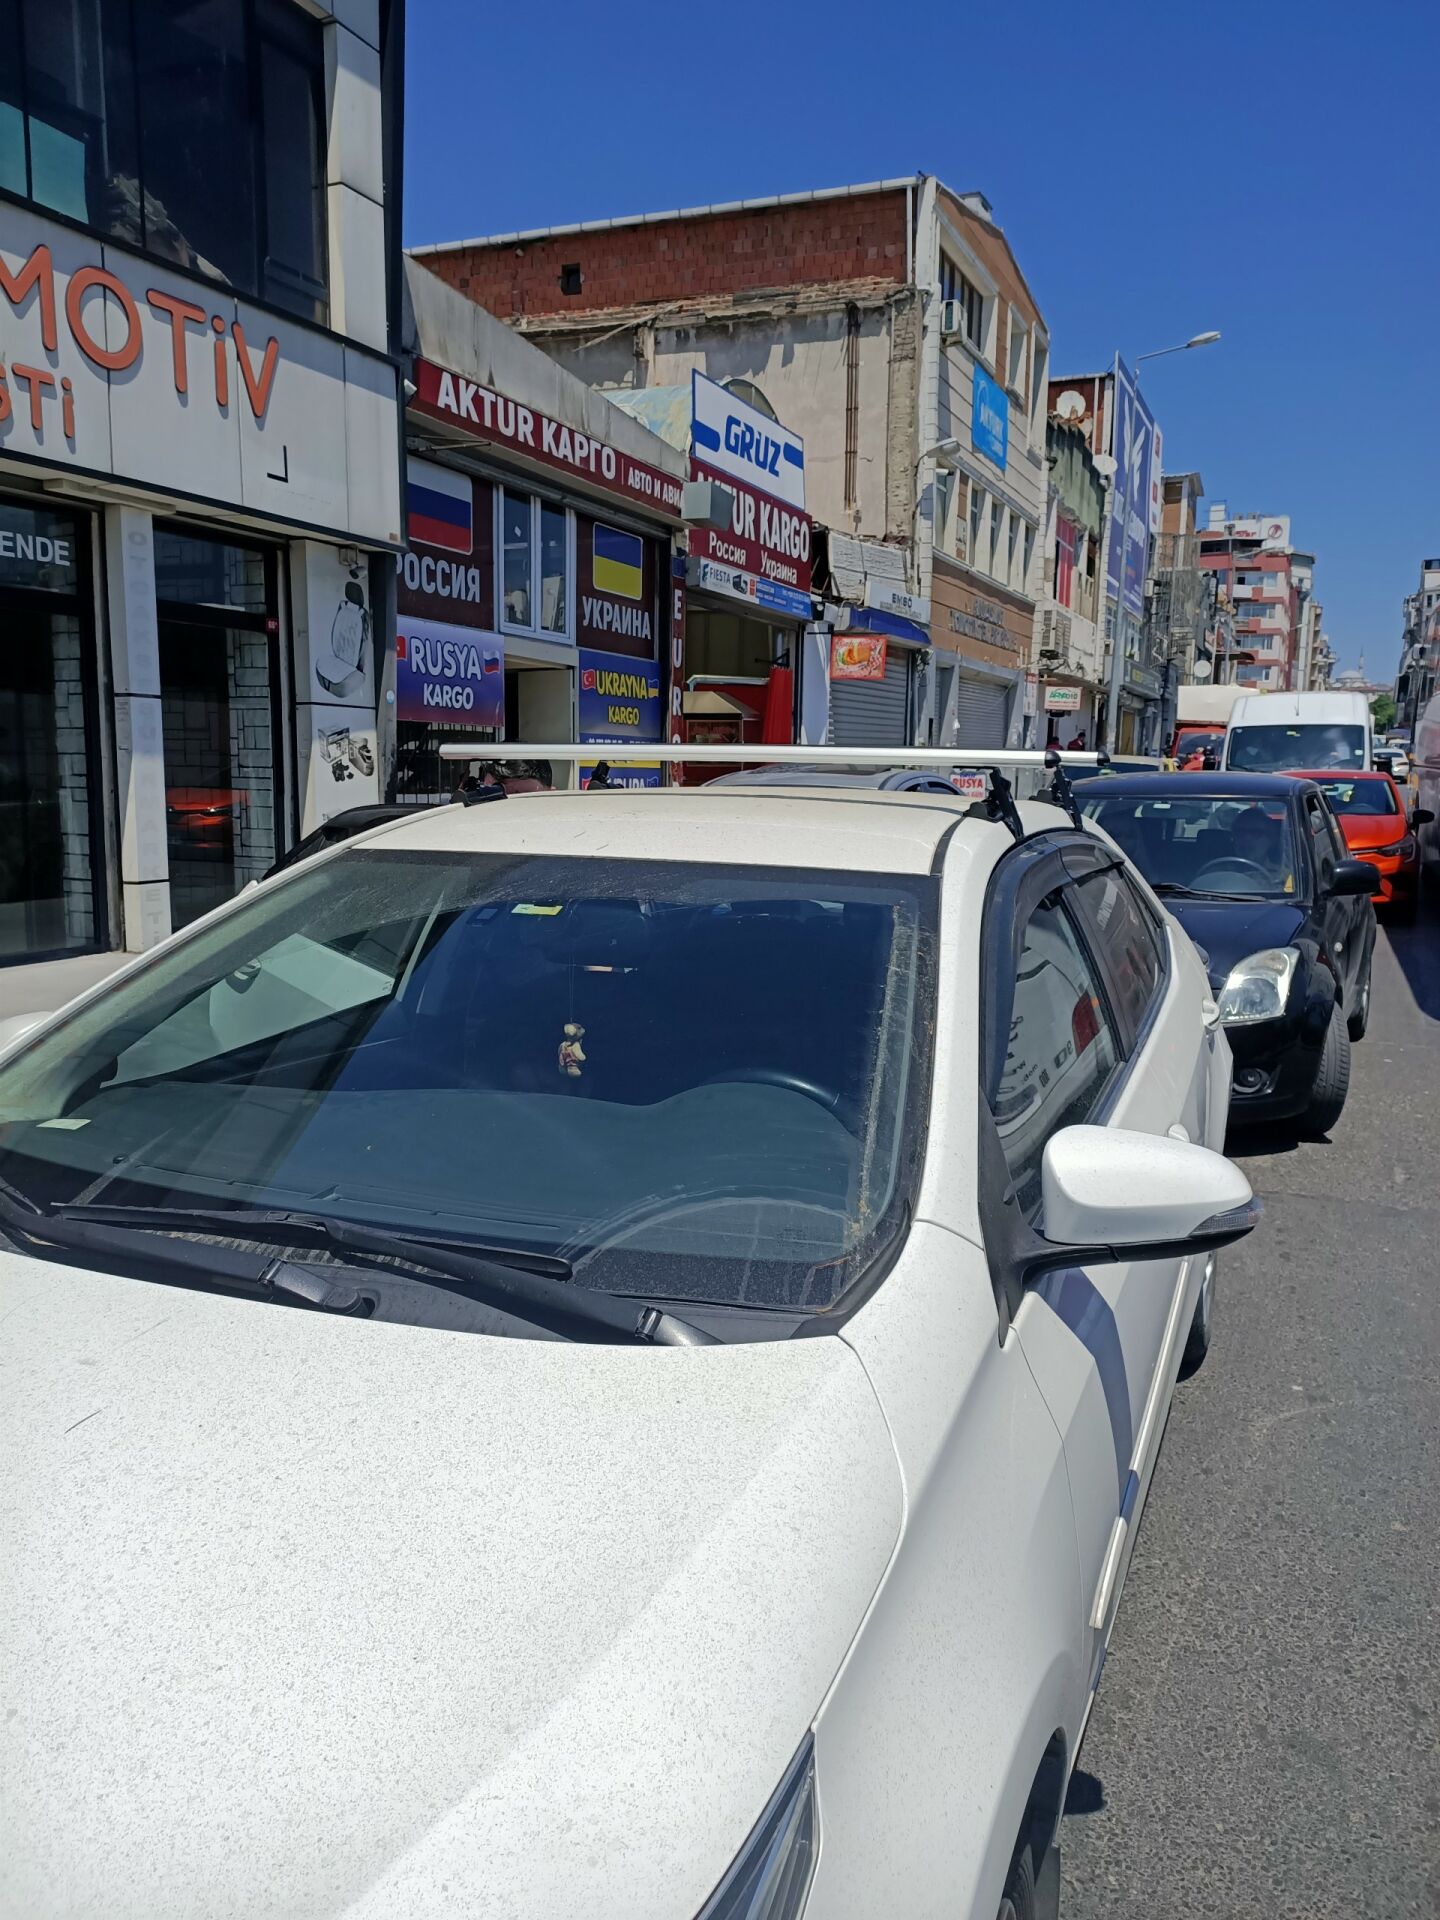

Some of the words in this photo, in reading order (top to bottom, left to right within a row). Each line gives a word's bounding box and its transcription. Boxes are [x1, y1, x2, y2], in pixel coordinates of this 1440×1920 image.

[437, 371, 535, 448] AKTUR
[542, 417, 616, 480] КАРГО
[628, 466, 652, 495] АВТО
[654, 478, 661, 500] И
[725, 415, 781, 477] GRUZ
[0, 530, 71, 566] ENDE
[760, 500, 810, 563] KARGO
[709, 530, 747, 566] Россия
[761, 550, 798, 584] Украина
[709, 567, 732, 585] FIESTA
[582, 595, 651, 640] УКРАИНА
[410, 636, 482, 681] RUSYA
[423, 682, 474, 710] KARGO
[595, 668, 648, 700] UKRAYNA
[607, 705, 640, 726] KARGO
